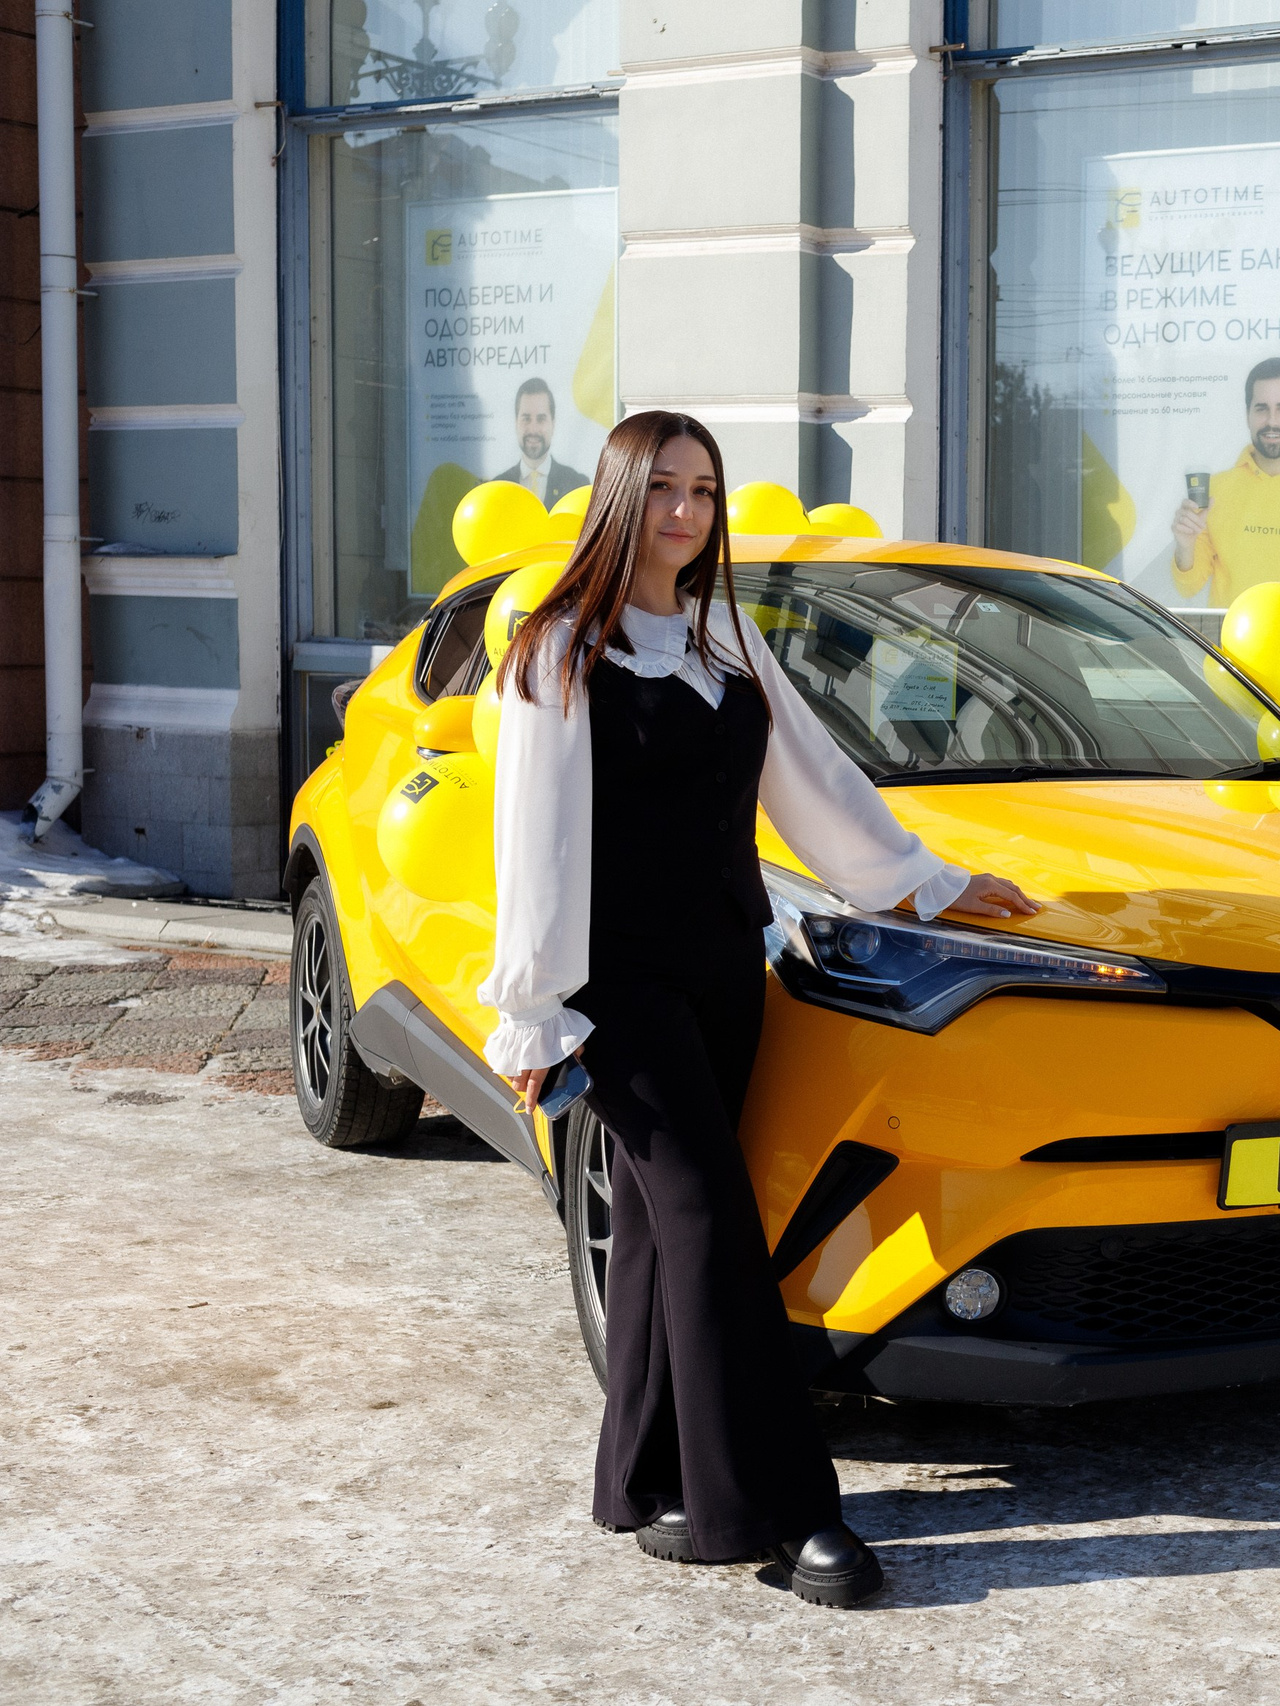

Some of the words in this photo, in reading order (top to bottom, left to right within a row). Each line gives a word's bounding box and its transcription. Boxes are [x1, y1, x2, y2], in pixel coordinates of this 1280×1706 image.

[1150, 184, 1264, 207] AUTOTIME
[457, 228, 543, 247] AUTOTIME
[1105, 249, 1232, 280] ВЕДУЩИЕ
[424, 284, 533, 310] ПОДБЕРЕМ
[539, 283, 554, 304] И
[1103, 289, 1118, 312] В
[1126, 284, 1237, 311] РЕЖИМЕ
[424, 315, 525, 342] ОДОБРИМ
[1103, 319, 1216, 348] ОДНОГО
[423, 344, 551, 370] АВТОКРЕДИТ
[1112, 391, 1172, 400] персональные
[1173, 391, 1207, 401] условия
[1112, 408, 1149, 417] решение
[1172, 406, 1201, 416] минут
